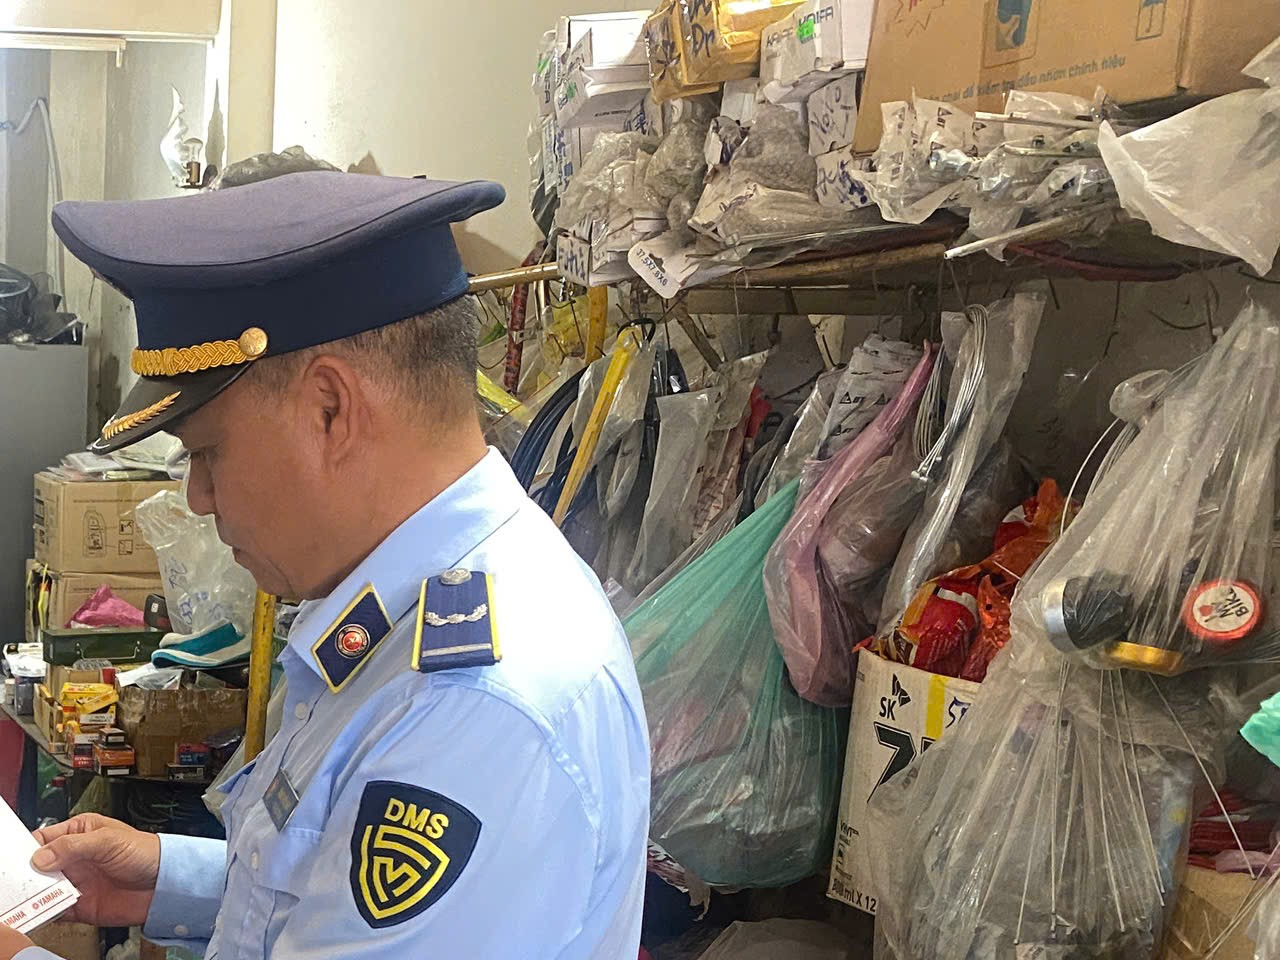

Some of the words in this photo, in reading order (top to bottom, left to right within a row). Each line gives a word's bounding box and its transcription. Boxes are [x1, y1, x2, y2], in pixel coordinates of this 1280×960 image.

[879, 697, 897, 721] SK
[384, 797, 449, 840] DMS
[39, 888, 65, 906] YAMAHA
[865, 895, 877, 912] 12
